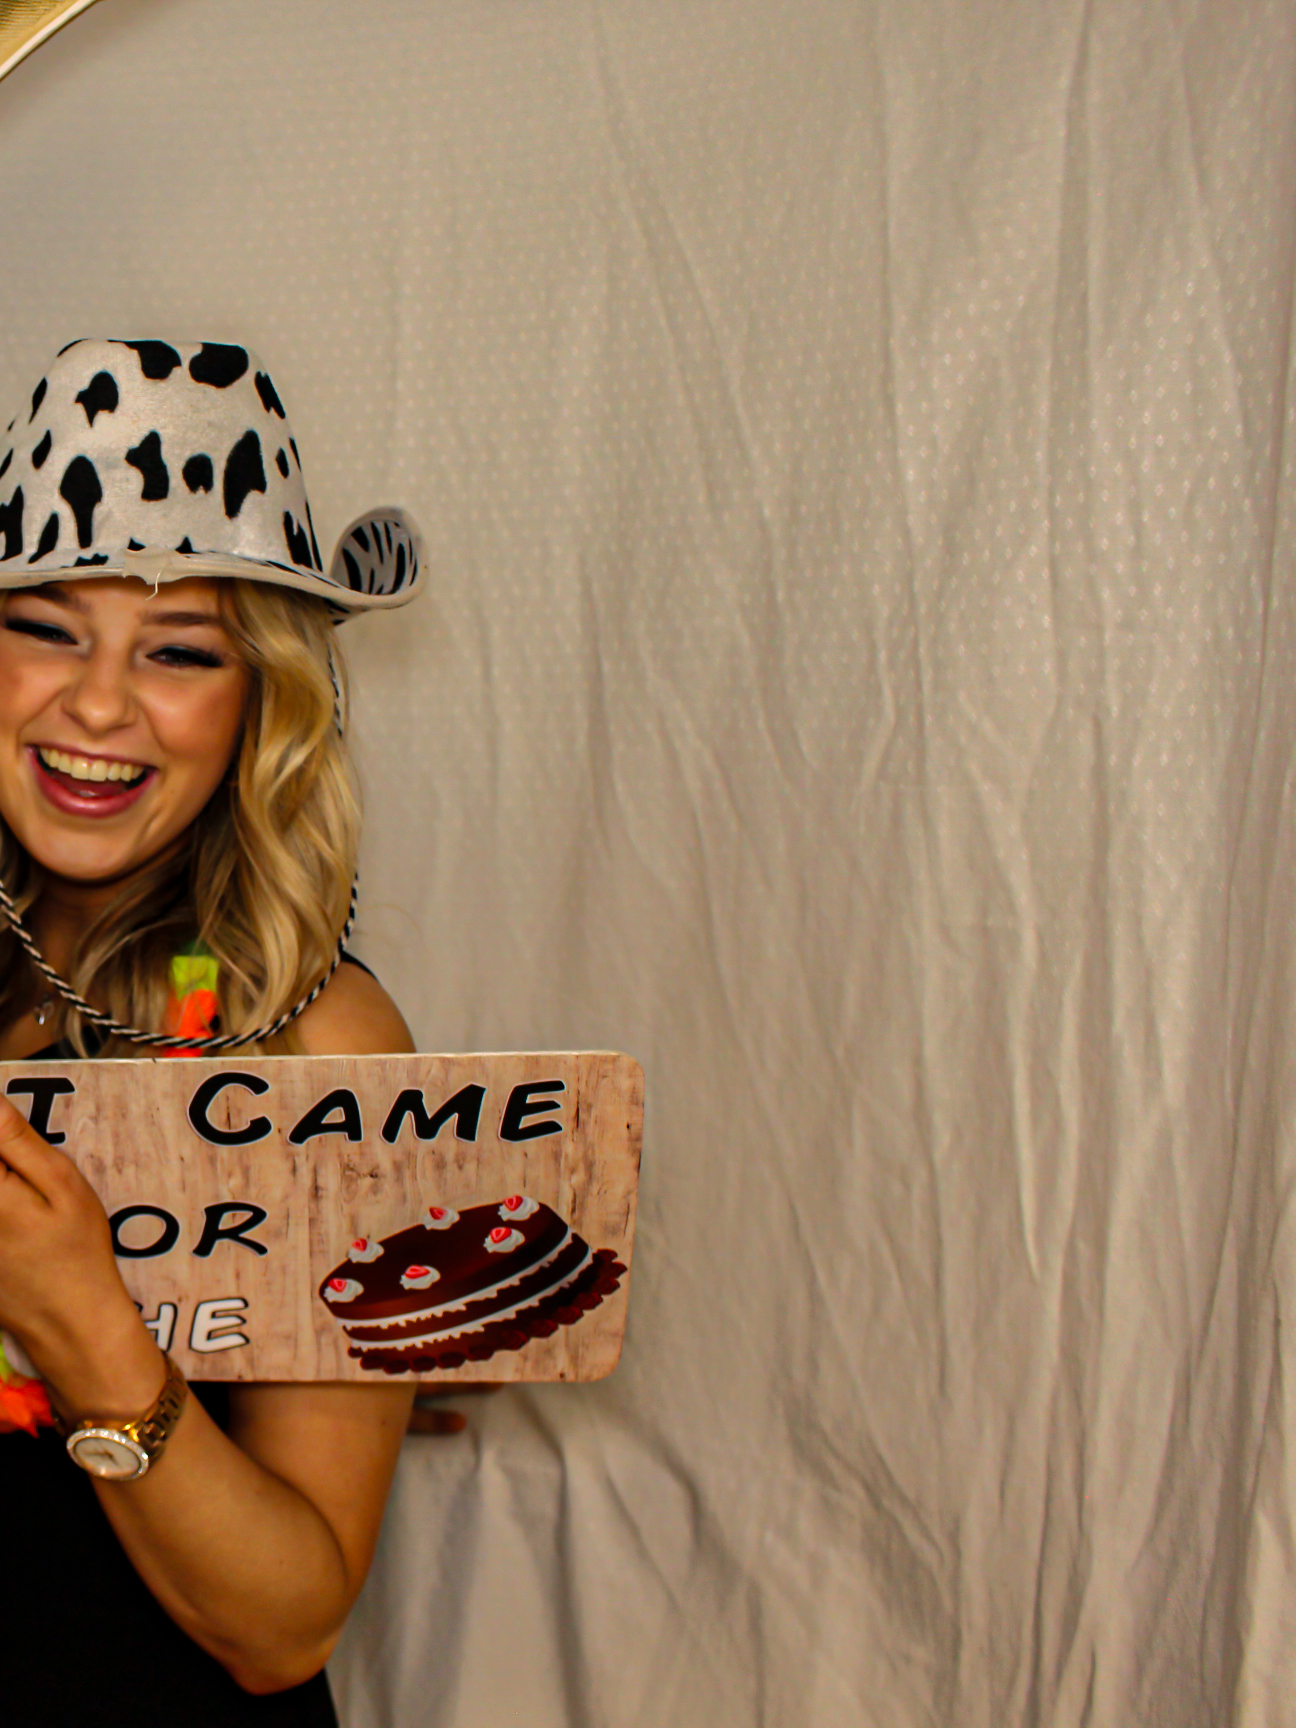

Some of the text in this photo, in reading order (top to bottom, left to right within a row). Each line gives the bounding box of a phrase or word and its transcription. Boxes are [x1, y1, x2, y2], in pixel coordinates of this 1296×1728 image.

[6, 1071, 567, 1146] I CAME
[108, 1201, 269, 1259] OR
[133, 1297, 251, 1354] HE
